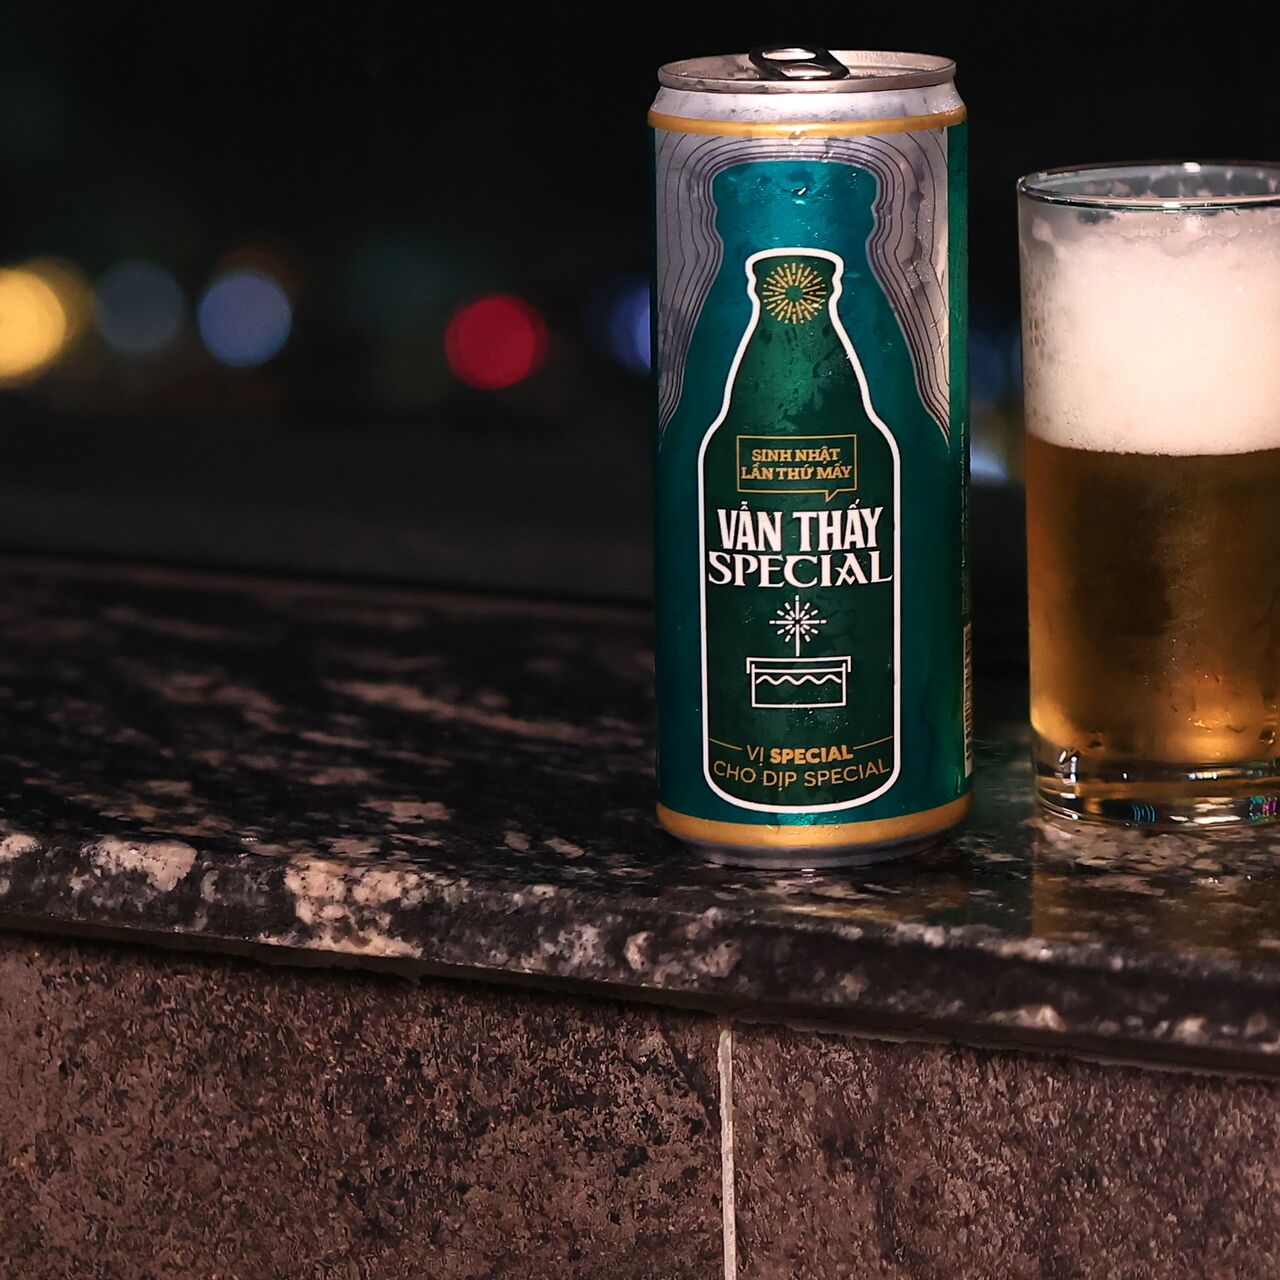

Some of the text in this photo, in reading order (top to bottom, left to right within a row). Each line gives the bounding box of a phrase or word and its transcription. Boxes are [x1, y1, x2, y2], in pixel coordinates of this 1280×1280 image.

[752, 445, 841, 464] SINH NHẬT
[717, 498, 884, 552] VẪN THẤY
[708, 551, 893, 588] SPECIAL
[747, 745, 854, 766] VỊ SPECIAL
[713, 759, 890, 791] CHO DỊP SPECIAL
